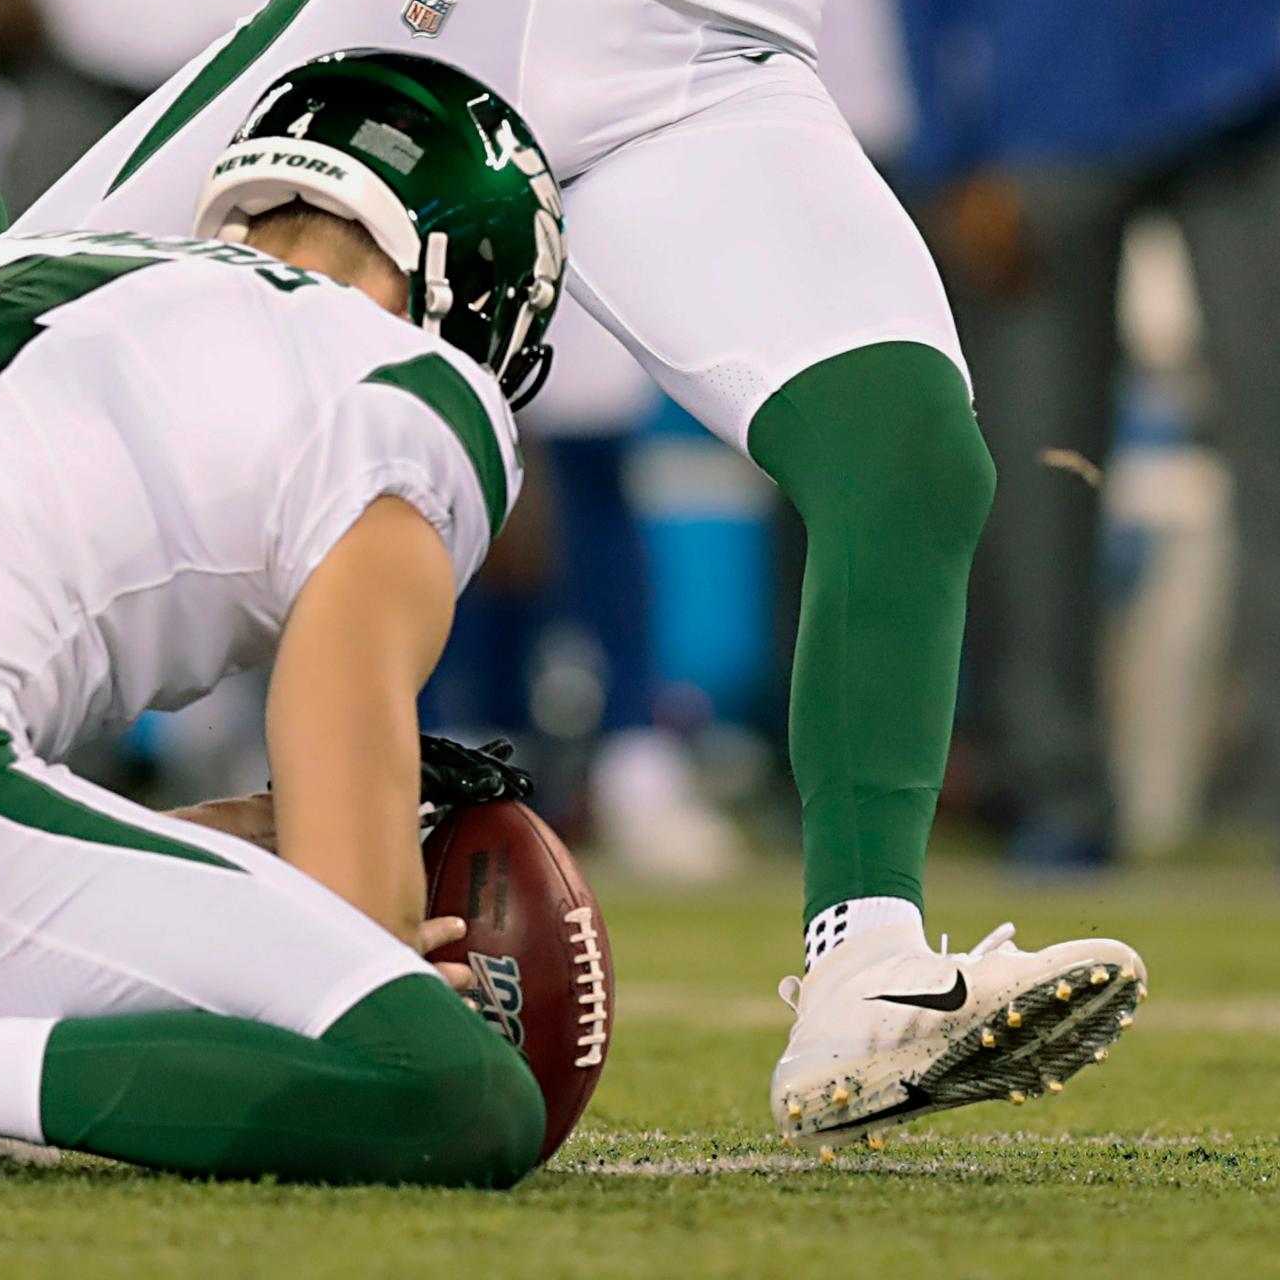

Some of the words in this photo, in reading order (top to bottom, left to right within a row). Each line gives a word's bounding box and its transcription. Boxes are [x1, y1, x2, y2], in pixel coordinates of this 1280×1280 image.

[286, 112, 315, 140] 4
[212, 152, 265, 180] NEW
[271, 152, 349, 181] YORK
